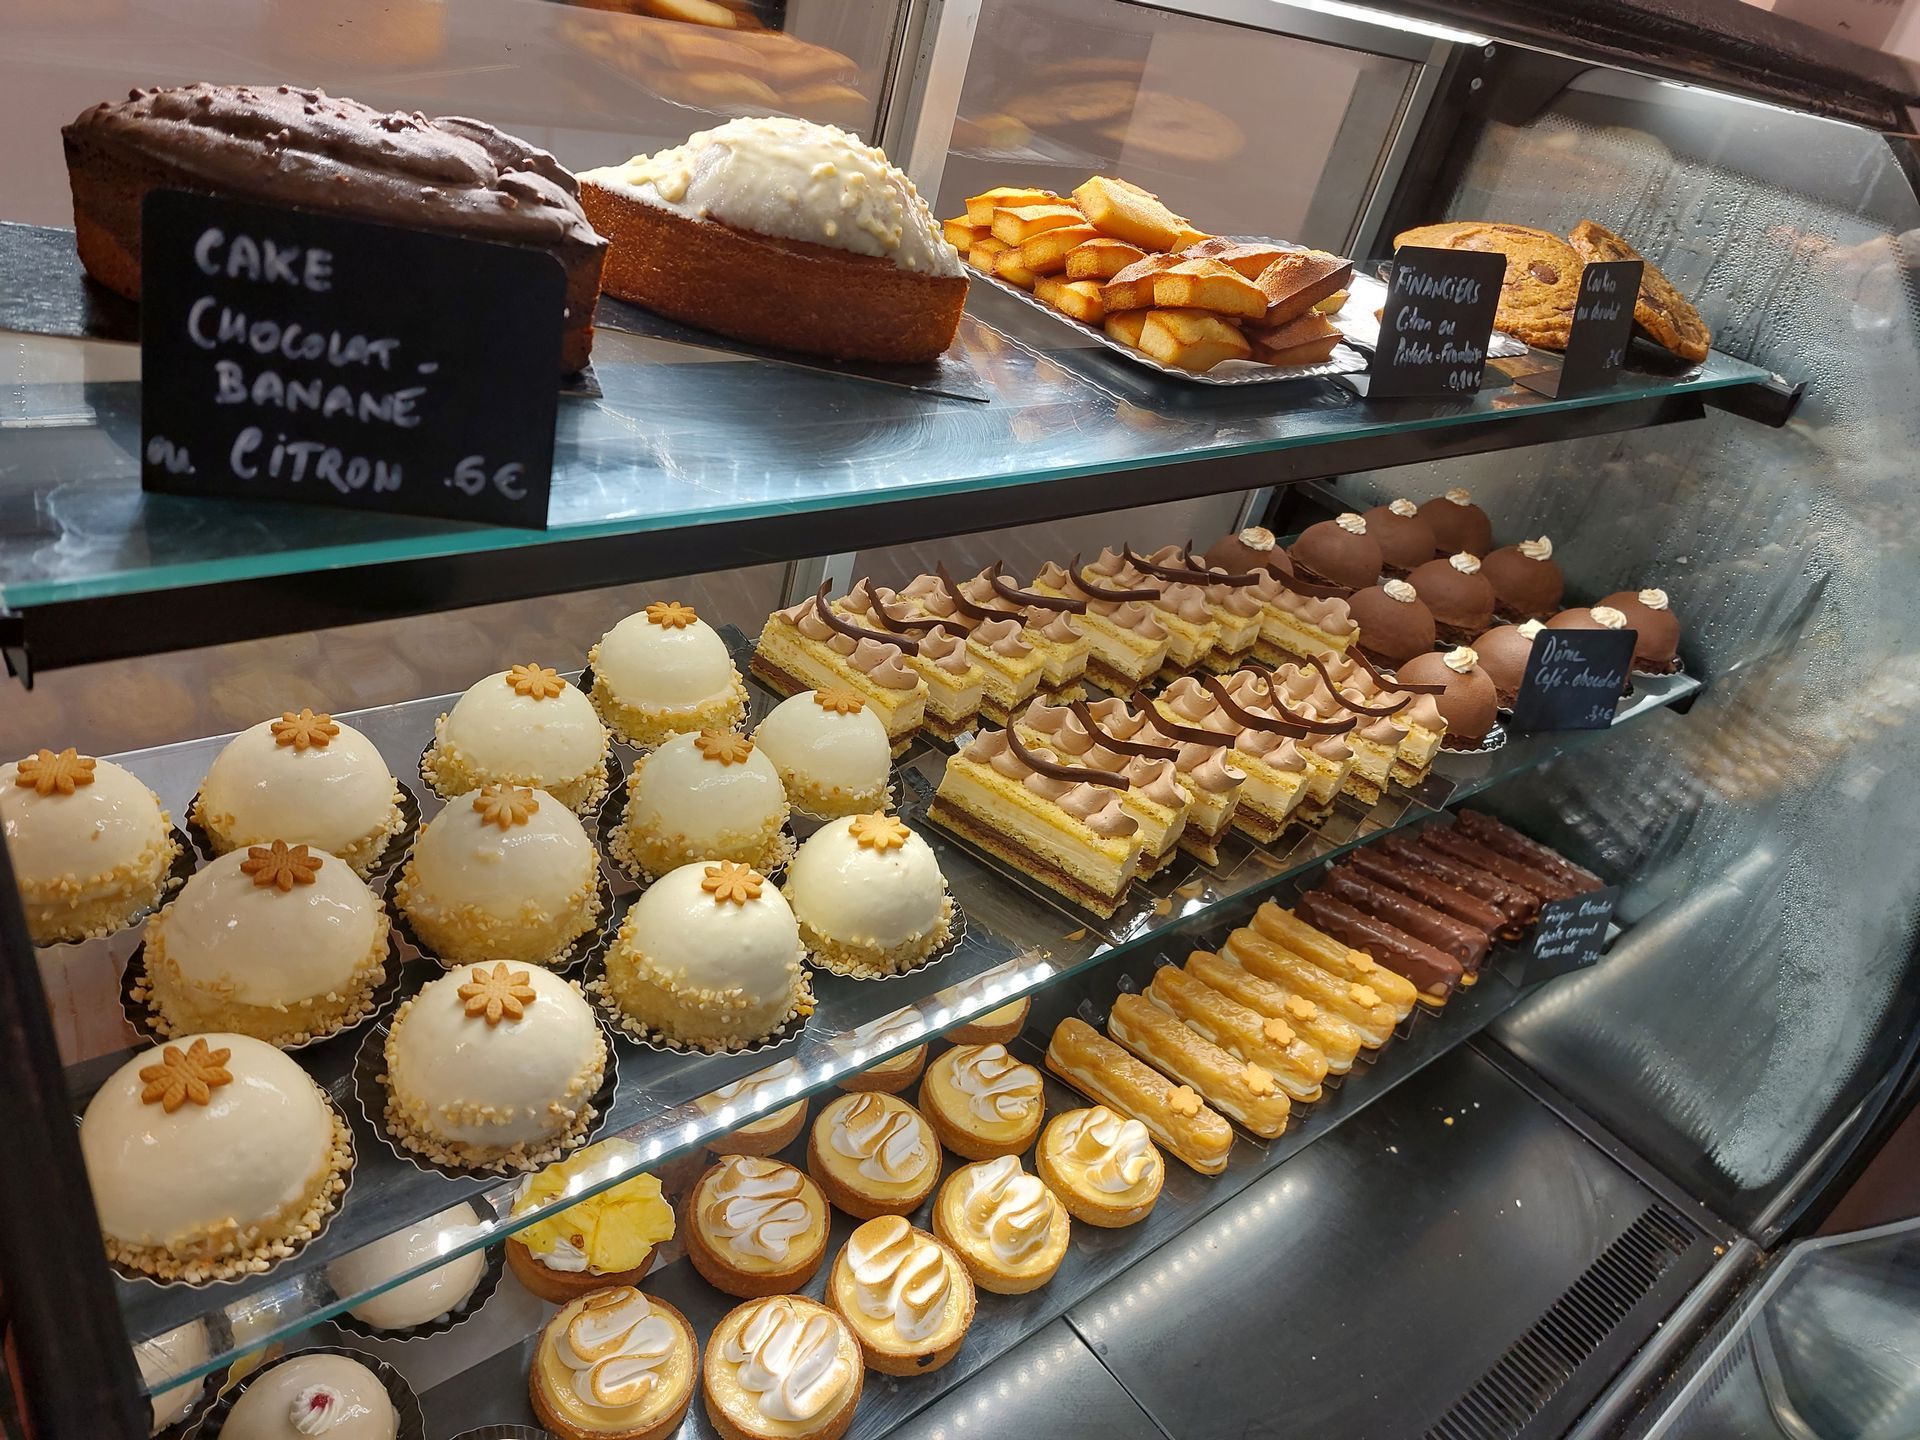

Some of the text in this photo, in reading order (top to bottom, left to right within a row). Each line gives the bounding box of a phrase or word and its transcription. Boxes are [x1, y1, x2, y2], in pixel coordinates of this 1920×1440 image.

[195, 227, 333, 292] CAKE
[187, 296, 399, 371] CHOCOLAT
[1438, 319, 1456, 336] ou
[215, 360, 427, 428] BANANE
